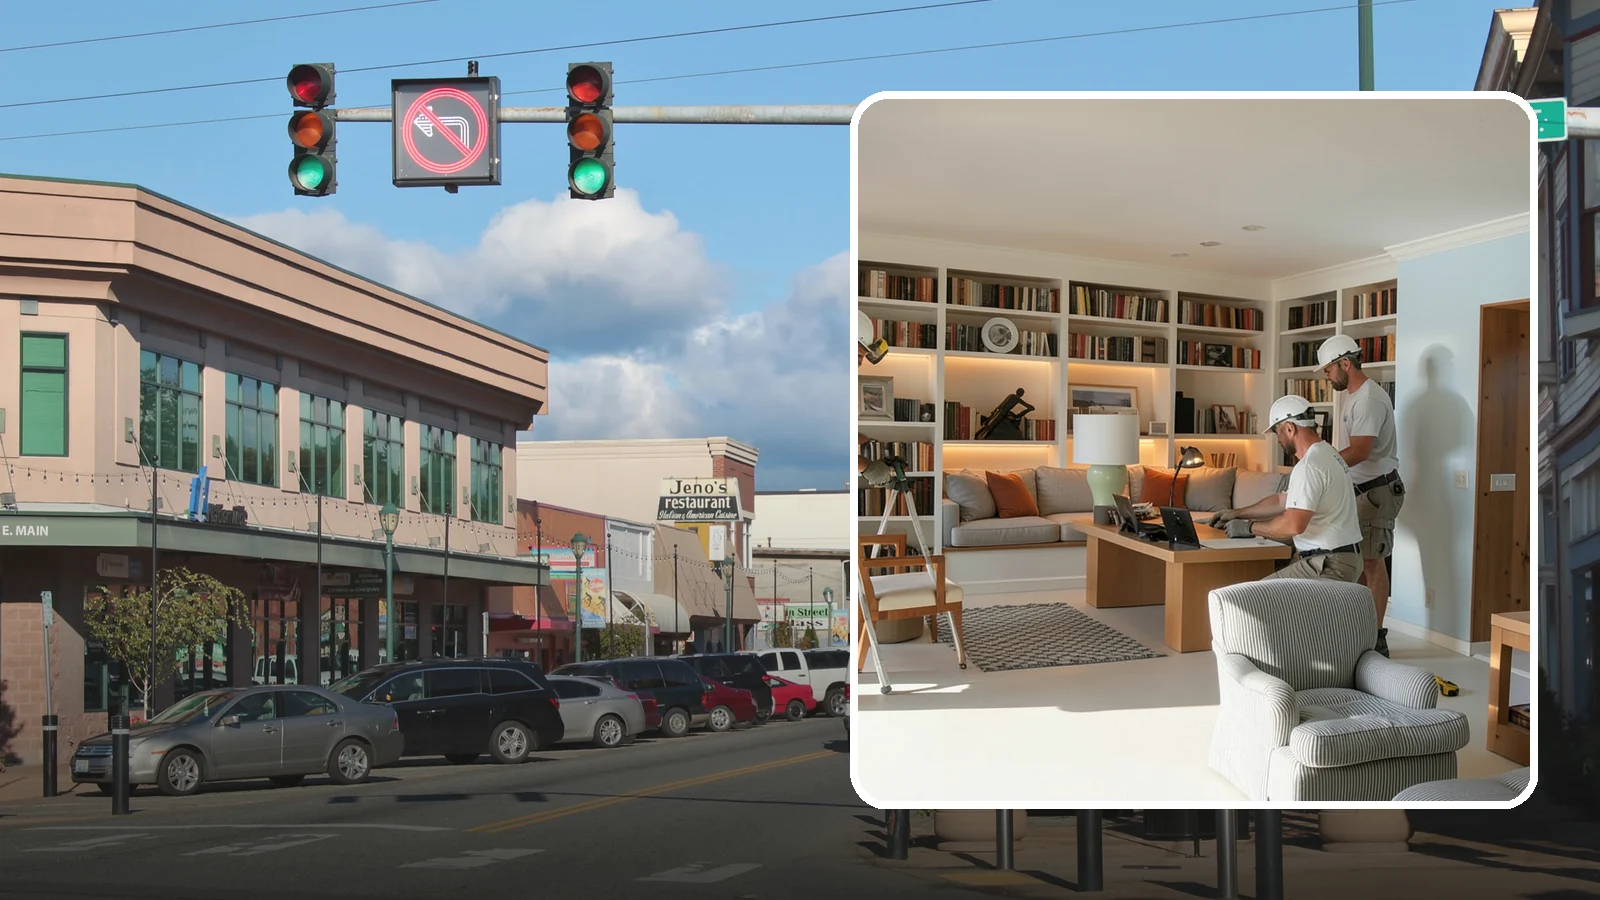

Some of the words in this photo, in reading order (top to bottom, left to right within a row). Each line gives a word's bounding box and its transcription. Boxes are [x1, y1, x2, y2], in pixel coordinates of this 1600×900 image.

[670, 480, 727, 494] Jeno's
[665, 497, 731, 509] restaurant
[658, 510, 681, 519] Italian
[686, 510, 714, 519] American
[715, 510, 738, 519] Cuisine
[2, 525, 13, 536] E.
[15, 525, 49, 536] MAIN
[797, 608, 828, 616] Street
[790, 619, 823, 627] lass
